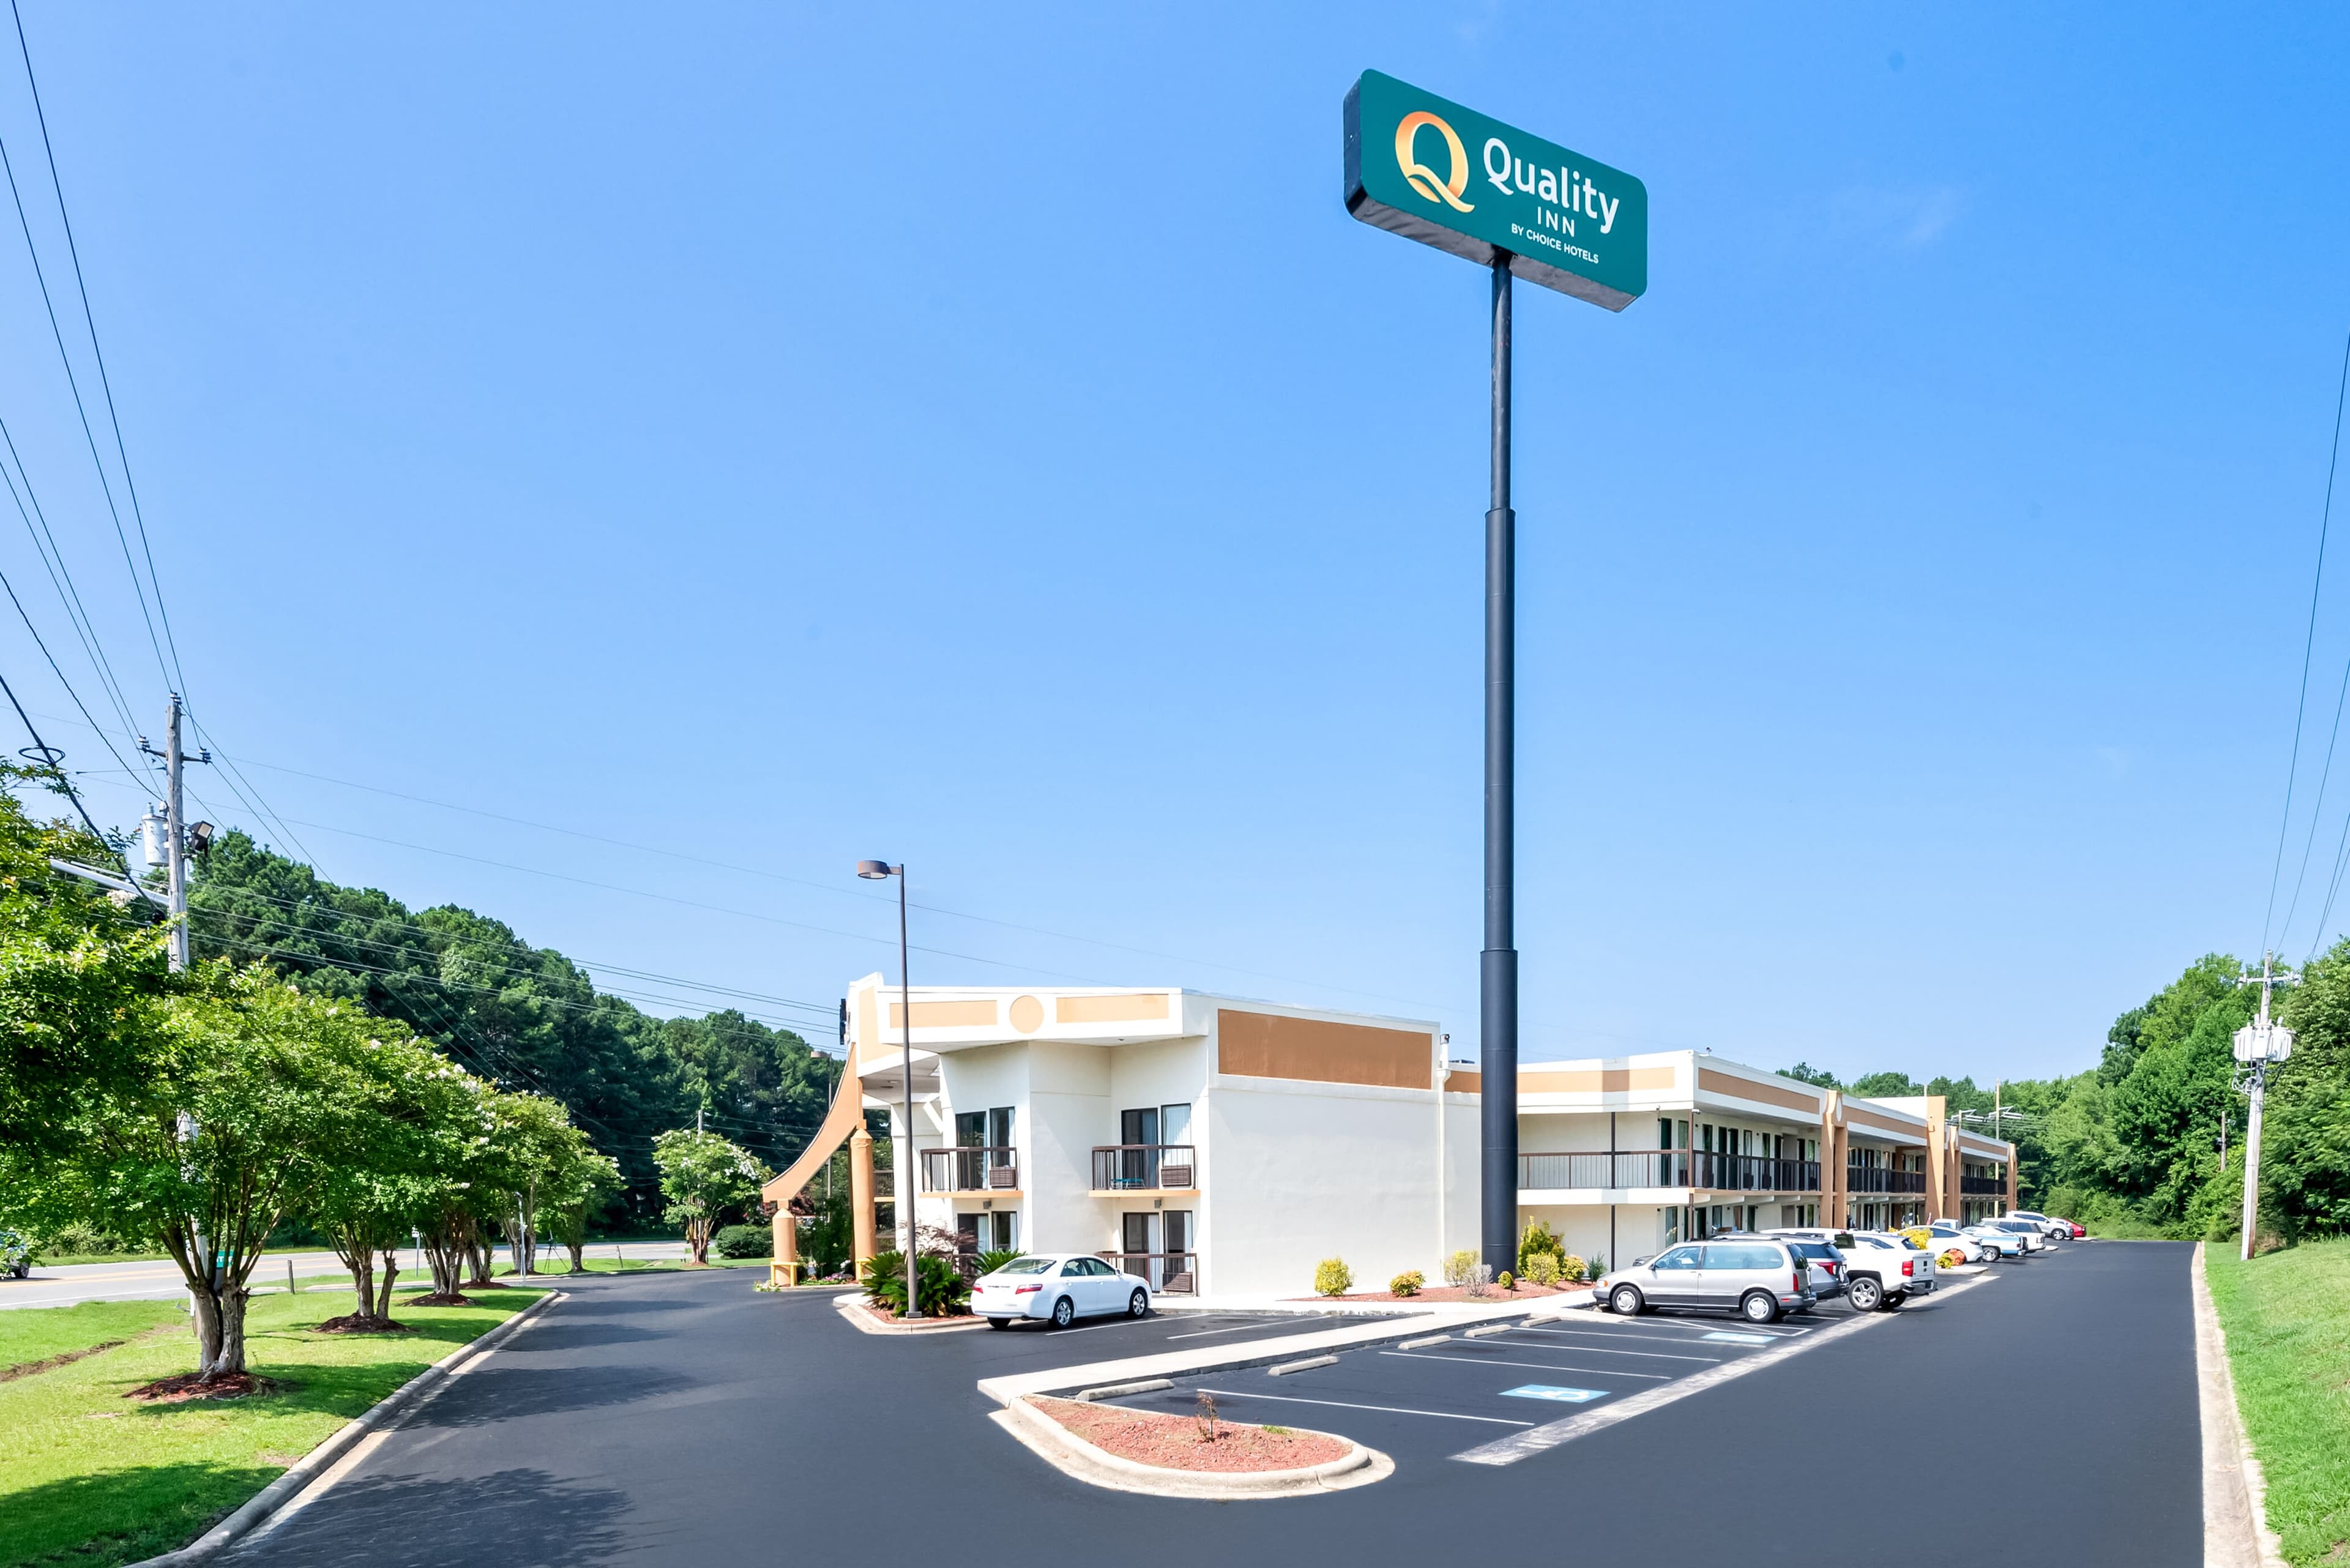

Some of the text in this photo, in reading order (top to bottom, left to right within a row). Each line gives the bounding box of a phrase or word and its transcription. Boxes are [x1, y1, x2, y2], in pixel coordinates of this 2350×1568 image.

[1483, 138, 1619, 234] Quality
[1537, 206, 1575, 237] INN
[1511, 223, 1599, 264] BY CHOICE HOTELS
